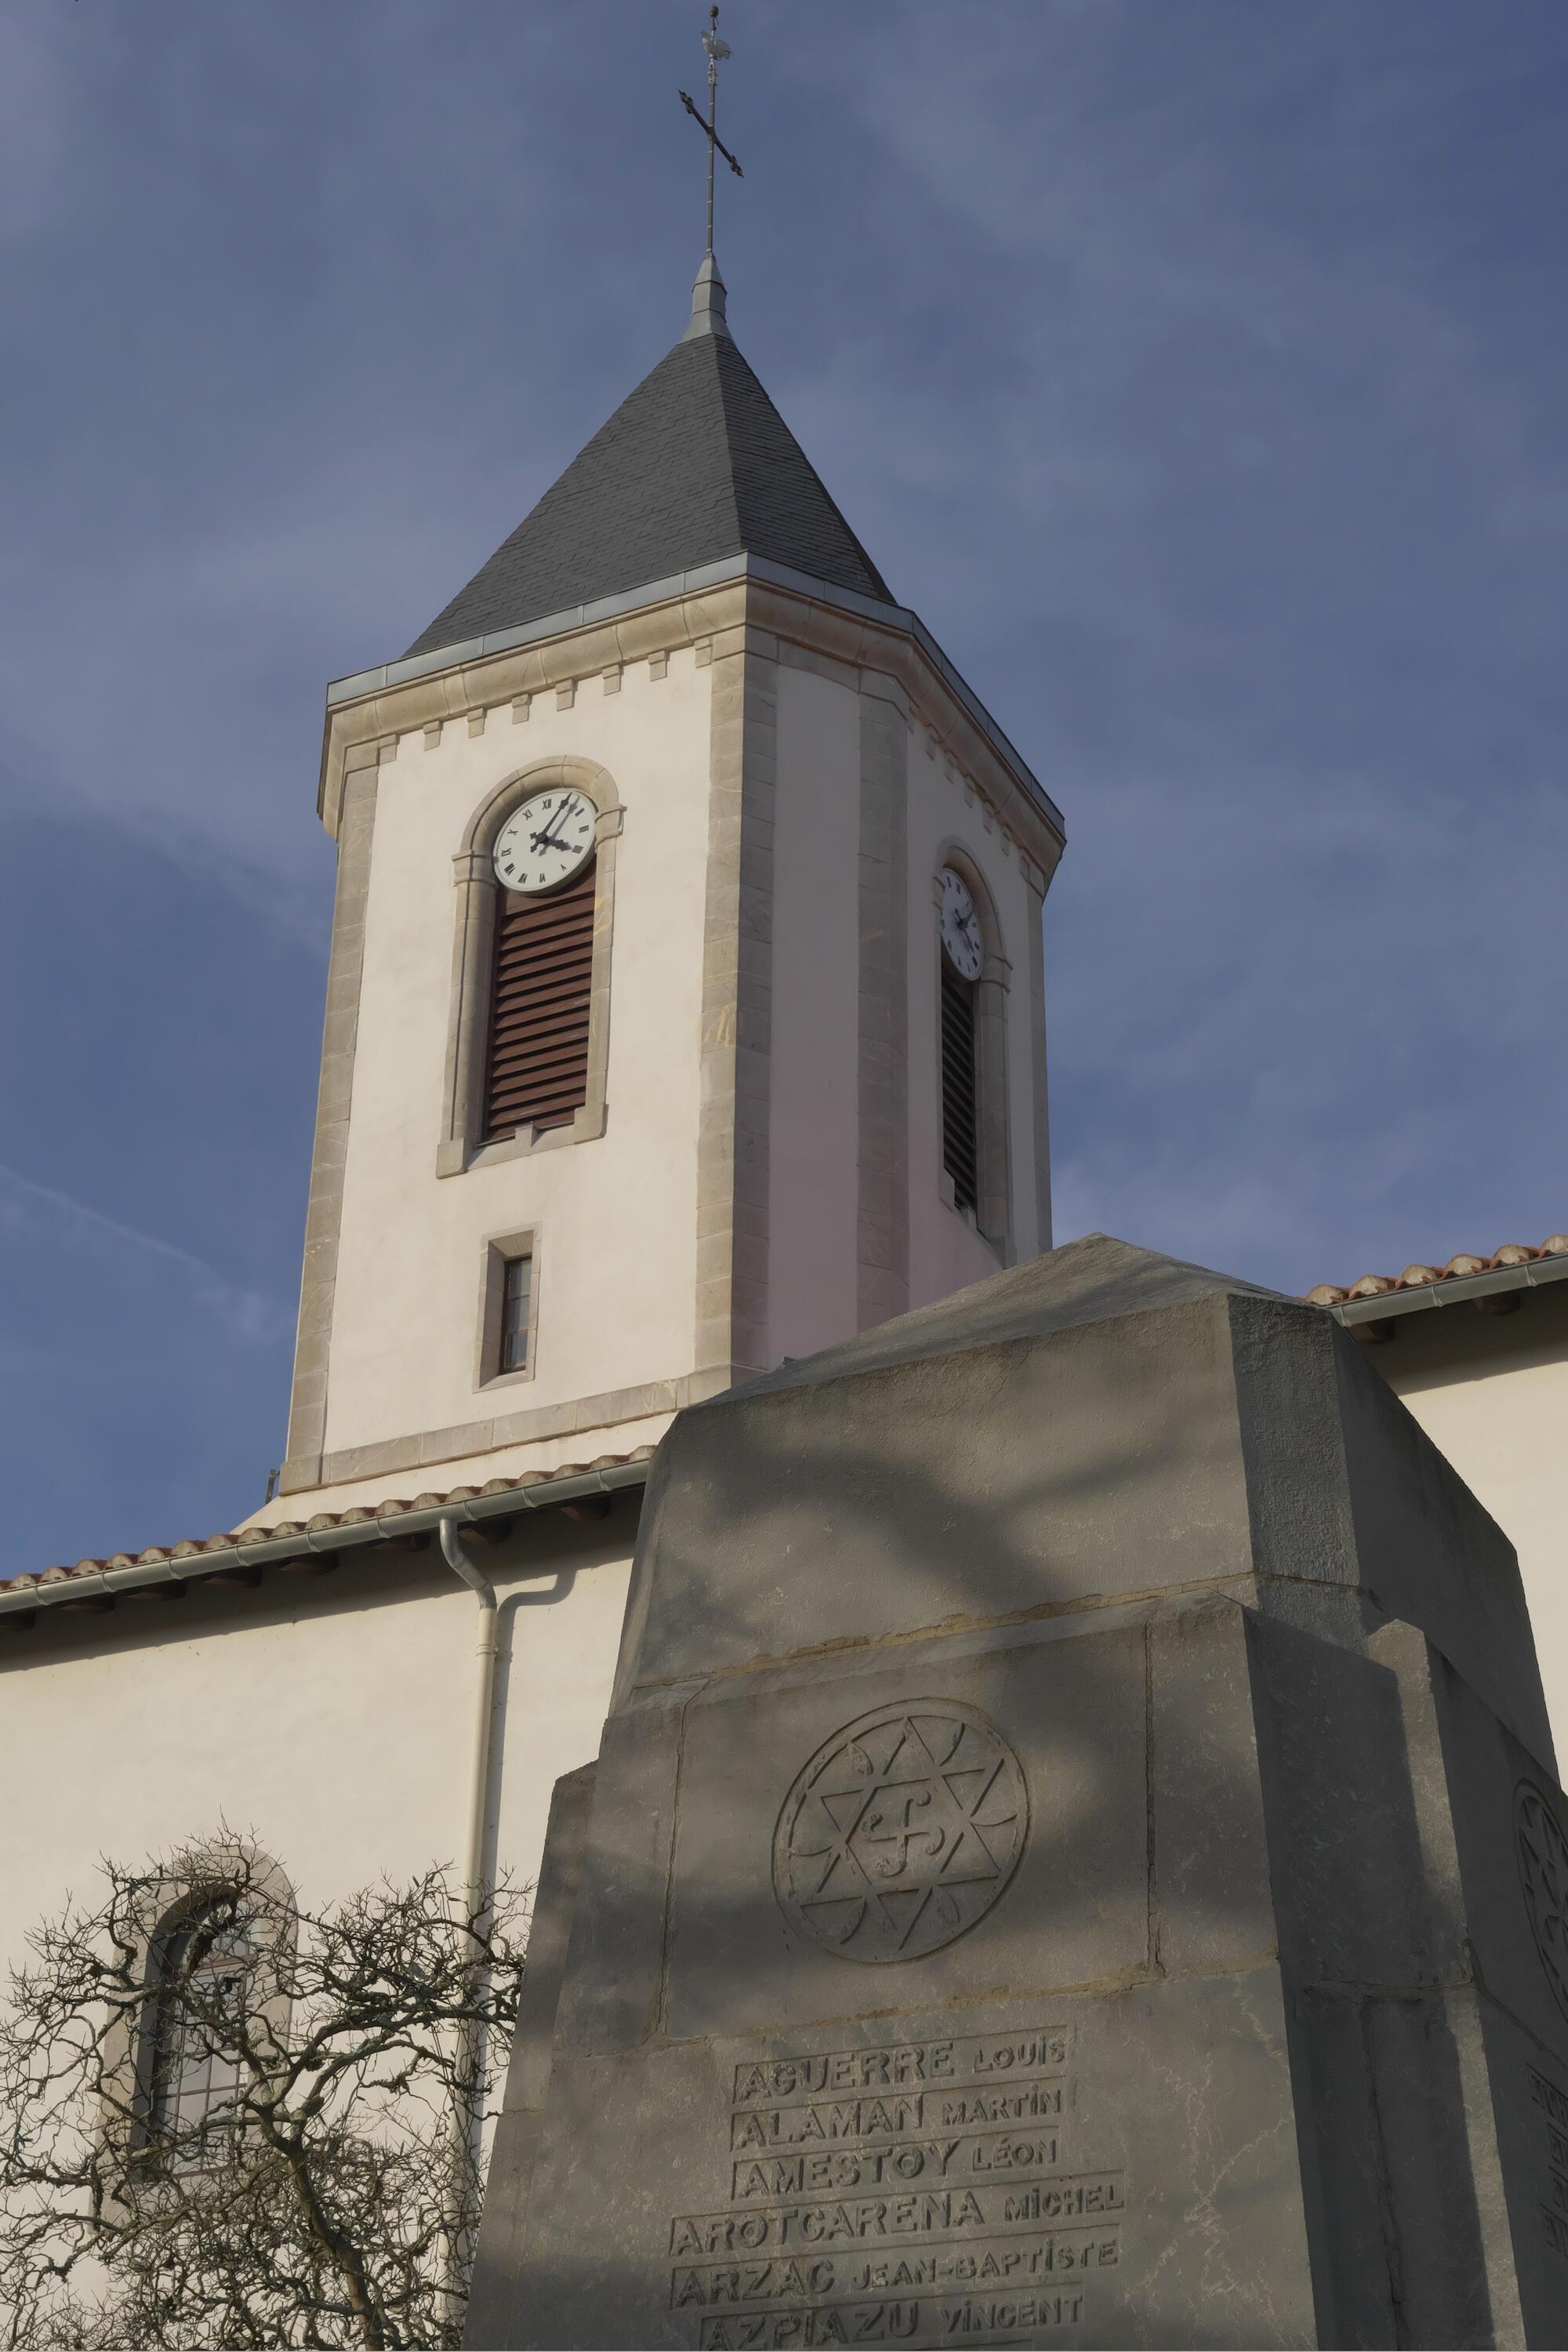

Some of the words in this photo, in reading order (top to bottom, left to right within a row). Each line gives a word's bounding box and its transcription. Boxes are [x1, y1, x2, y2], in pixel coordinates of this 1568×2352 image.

[735, 2042, 954, 2103] AGUERRE
[735, 2094, 924, 2151] ALAMAN
[738, 2139, 961, 2198] AMESTOY
[971, 2136, 1057, 2172] LÉON
[672, 2190, 985, 2256] AROTCARENA
[674, 2259, 837, 2307] ARZAC
[707, 2304, 919, 2352] AZPIAZU
